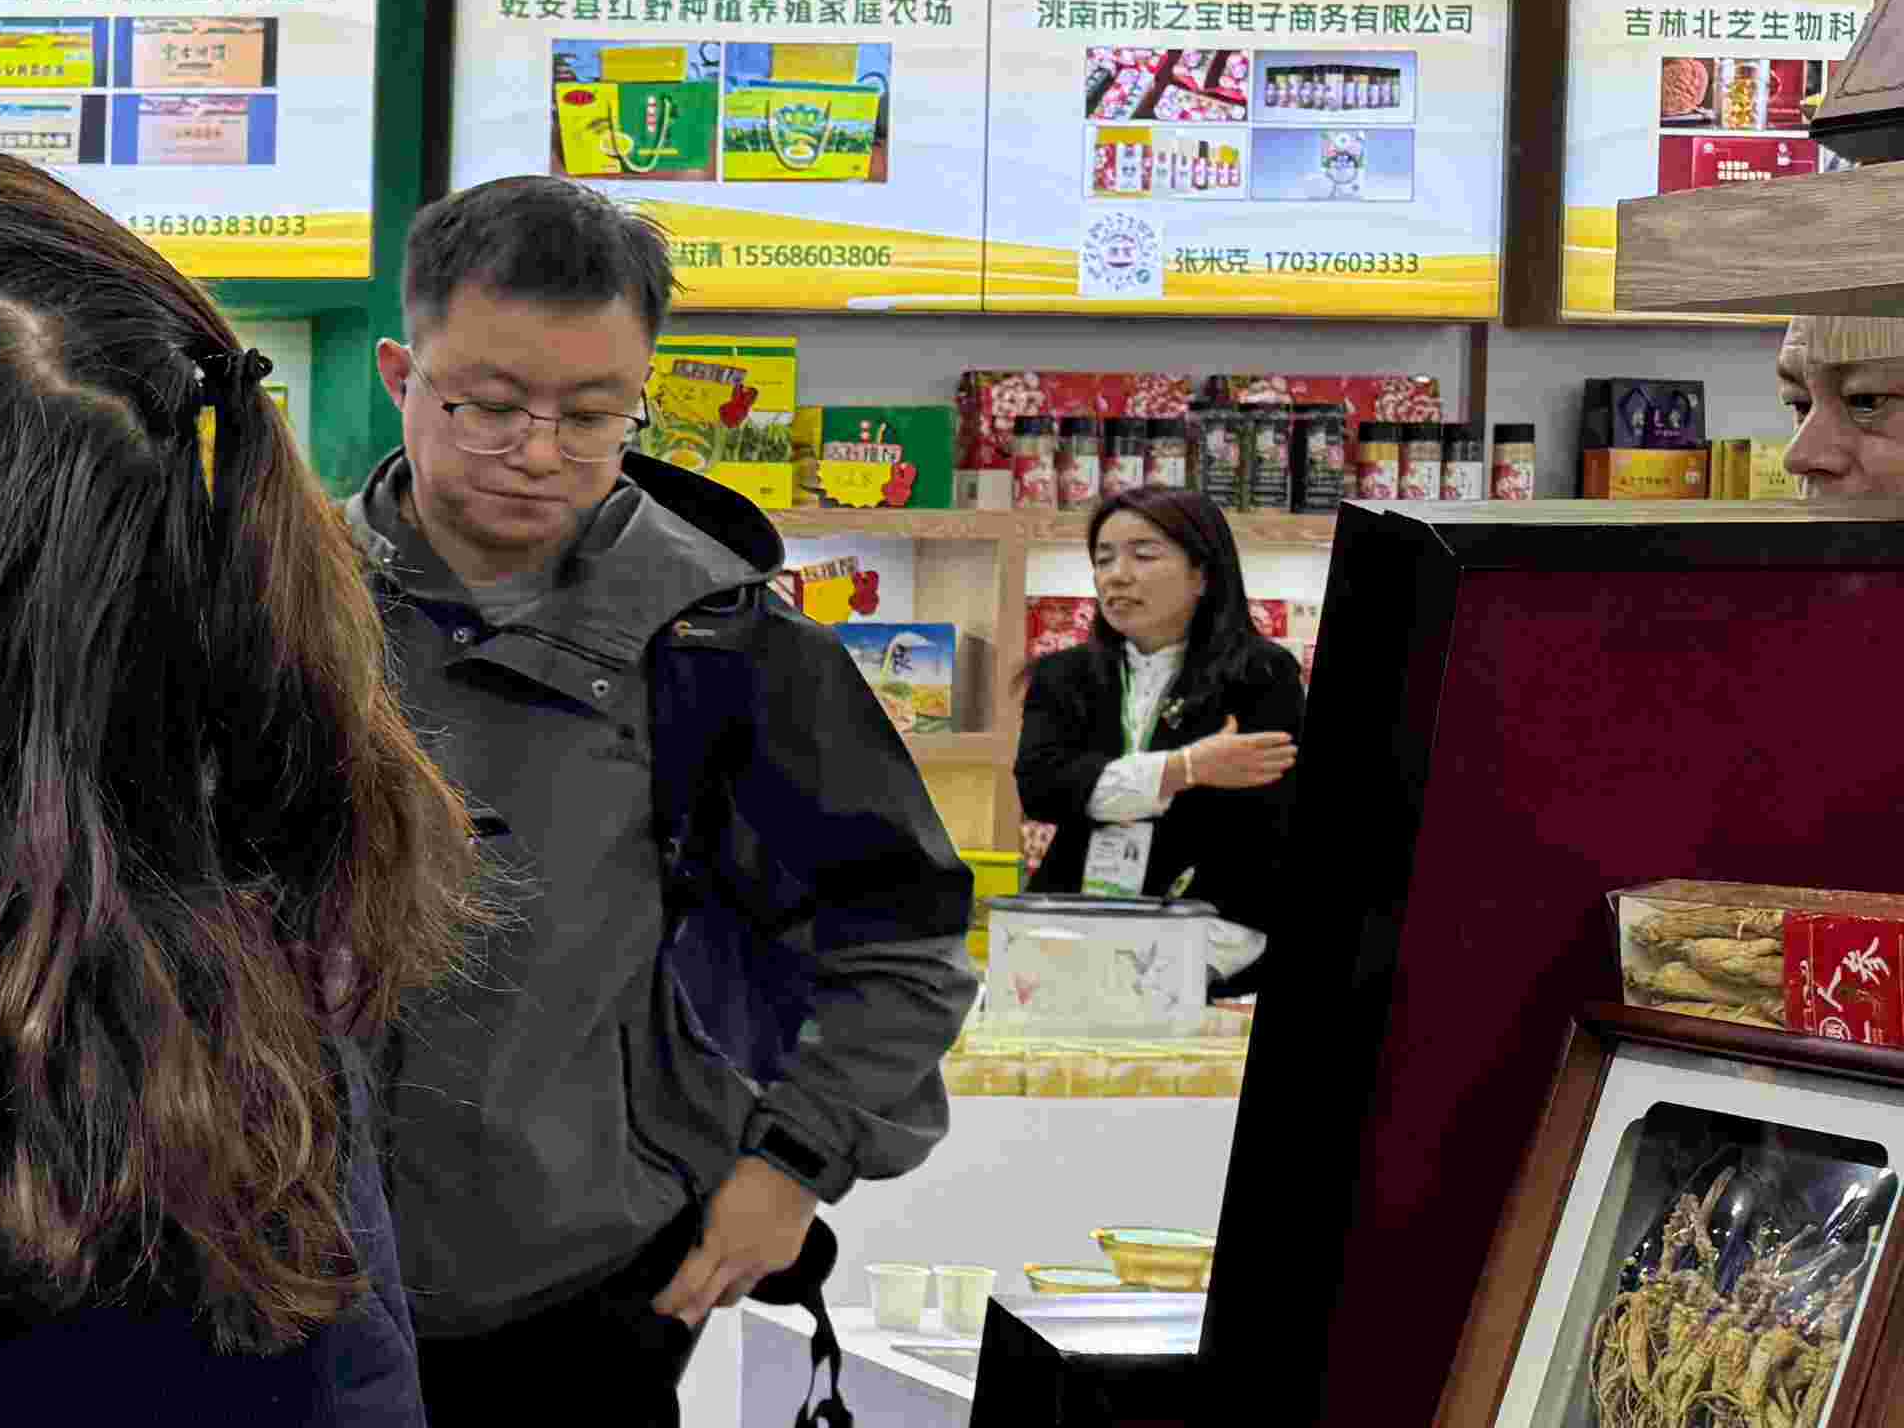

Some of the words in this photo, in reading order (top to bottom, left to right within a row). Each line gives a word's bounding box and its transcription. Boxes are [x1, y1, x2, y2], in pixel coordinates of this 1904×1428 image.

[1036, 0, 1473, 34] 洮南市洮之宝电子商务有限公司
[1625, 6, 1864, 41] 吉林北芝生物科
[127, 215, 307, 237] 13630383033
[734, 244, 892, 268] 15568603806
[1263, 251, 1419, 275] 17037603333
